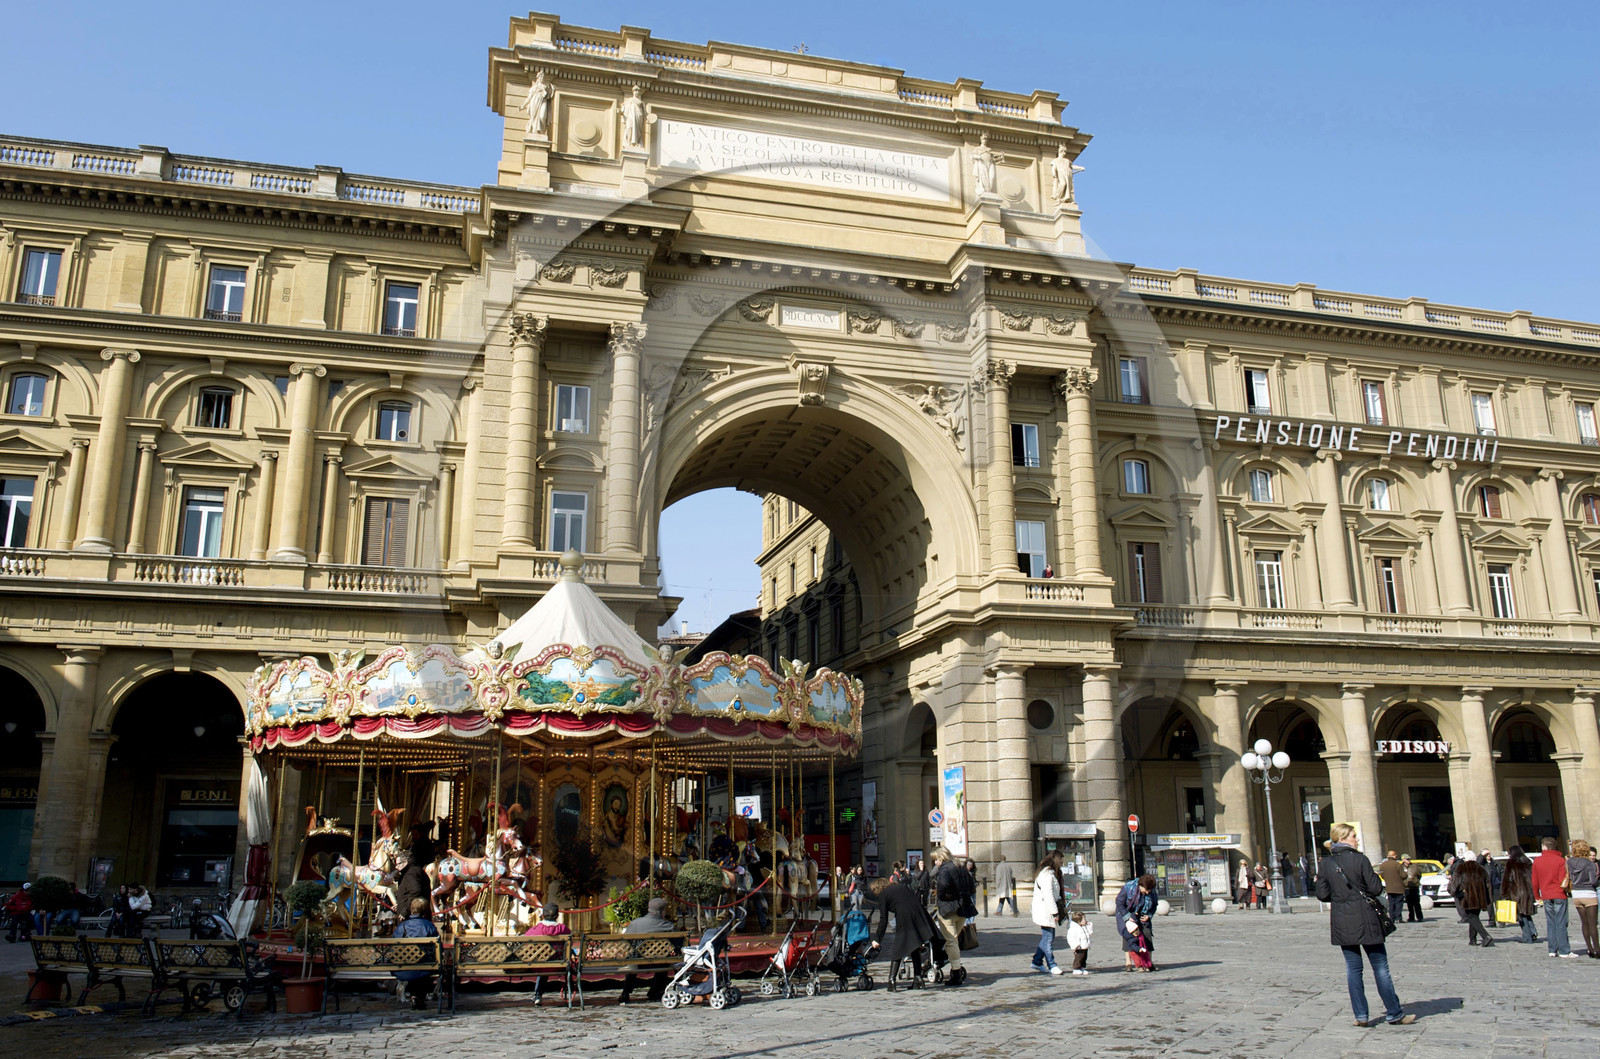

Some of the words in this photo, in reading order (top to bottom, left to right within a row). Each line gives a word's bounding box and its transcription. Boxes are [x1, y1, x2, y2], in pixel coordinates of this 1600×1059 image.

[687, 127, 749, 144] ANTICO
[755, 135, 823, 154] CENTRO
[830, 145, 884, 163] DELLA
[692, 141, 714, 153] DA
[722, 145, 812, 166] SECOLARE
[820, 157, 918, 180] SQUALLORE
[692, 154, 701, 165] A
[710, 156, 749, 171] VITA
[759, 163, 813, 179] NUOVA
[821, 170, 919, 193] RESTITUITO
[784, 311, 835, 323] MDCCCXCV
[1215, 415, 1363, 451] PENSIONE
[1387, 431, 1498, 463] PENDINI
[1376, 740, 1449, 753] EDISON
[15, 787, 39, 798] BN
[195, 789, 233, 800] BNL
